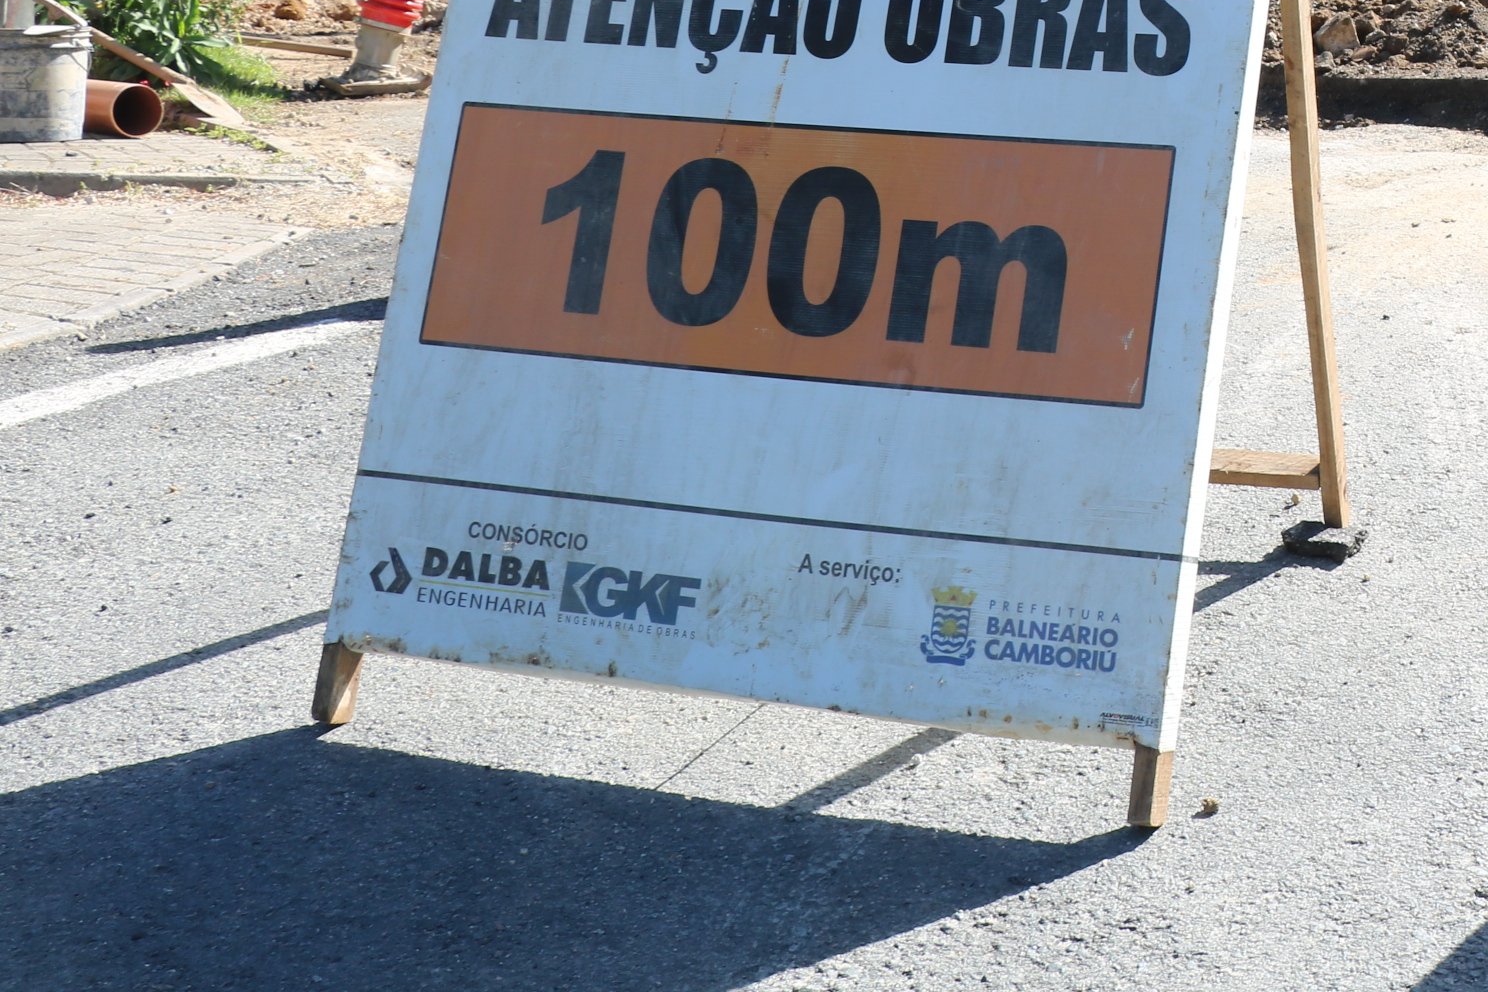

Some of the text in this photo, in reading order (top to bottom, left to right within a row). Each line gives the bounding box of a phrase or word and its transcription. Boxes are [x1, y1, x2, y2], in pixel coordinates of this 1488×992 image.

[540, 149, 1069, 354] 100m
[468, 521, 588, 551] CONSÓRCIO
[421, 546, 550, 591] DALBA
[798, 553, 901, 586] A serviço:
[416, 587, 547, 618] ENGENHARIA
[988, 599, 1121, 624] PREFEITURA
[557, 613, 696, 640] ENGENHARIA DE OBRAS
[986, 616, 1119, 648] BALNEÁRIO
[984, 639, 1117, 673] CAMBORIÚ
